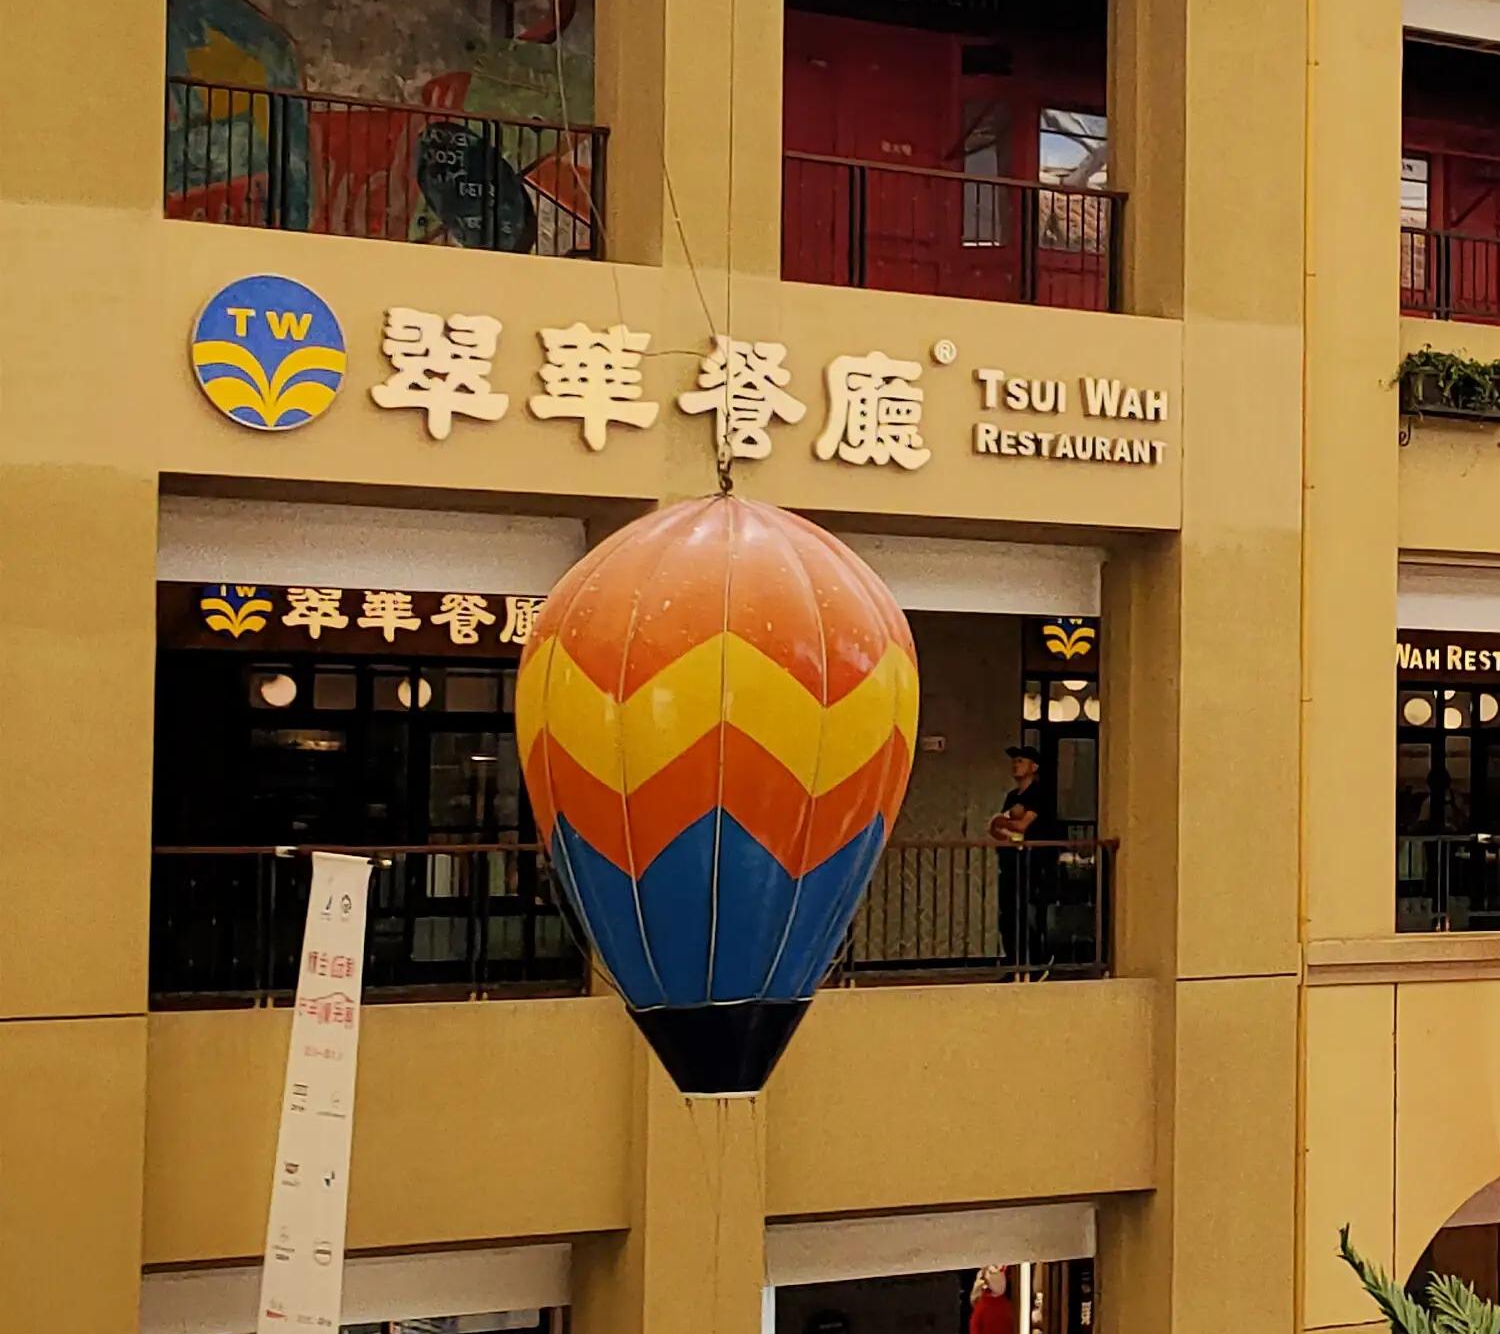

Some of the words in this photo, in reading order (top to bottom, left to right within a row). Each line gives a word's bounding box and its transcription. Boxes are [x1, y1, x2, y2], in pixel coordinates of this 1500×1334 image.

[371, 306, 934, 471] 翠華餐廳
[976, 369, 1067, 415] TSUI
[1079, 375, 1169, 423] WAH
[976, 422, 1168, 466] RESTAURANT
